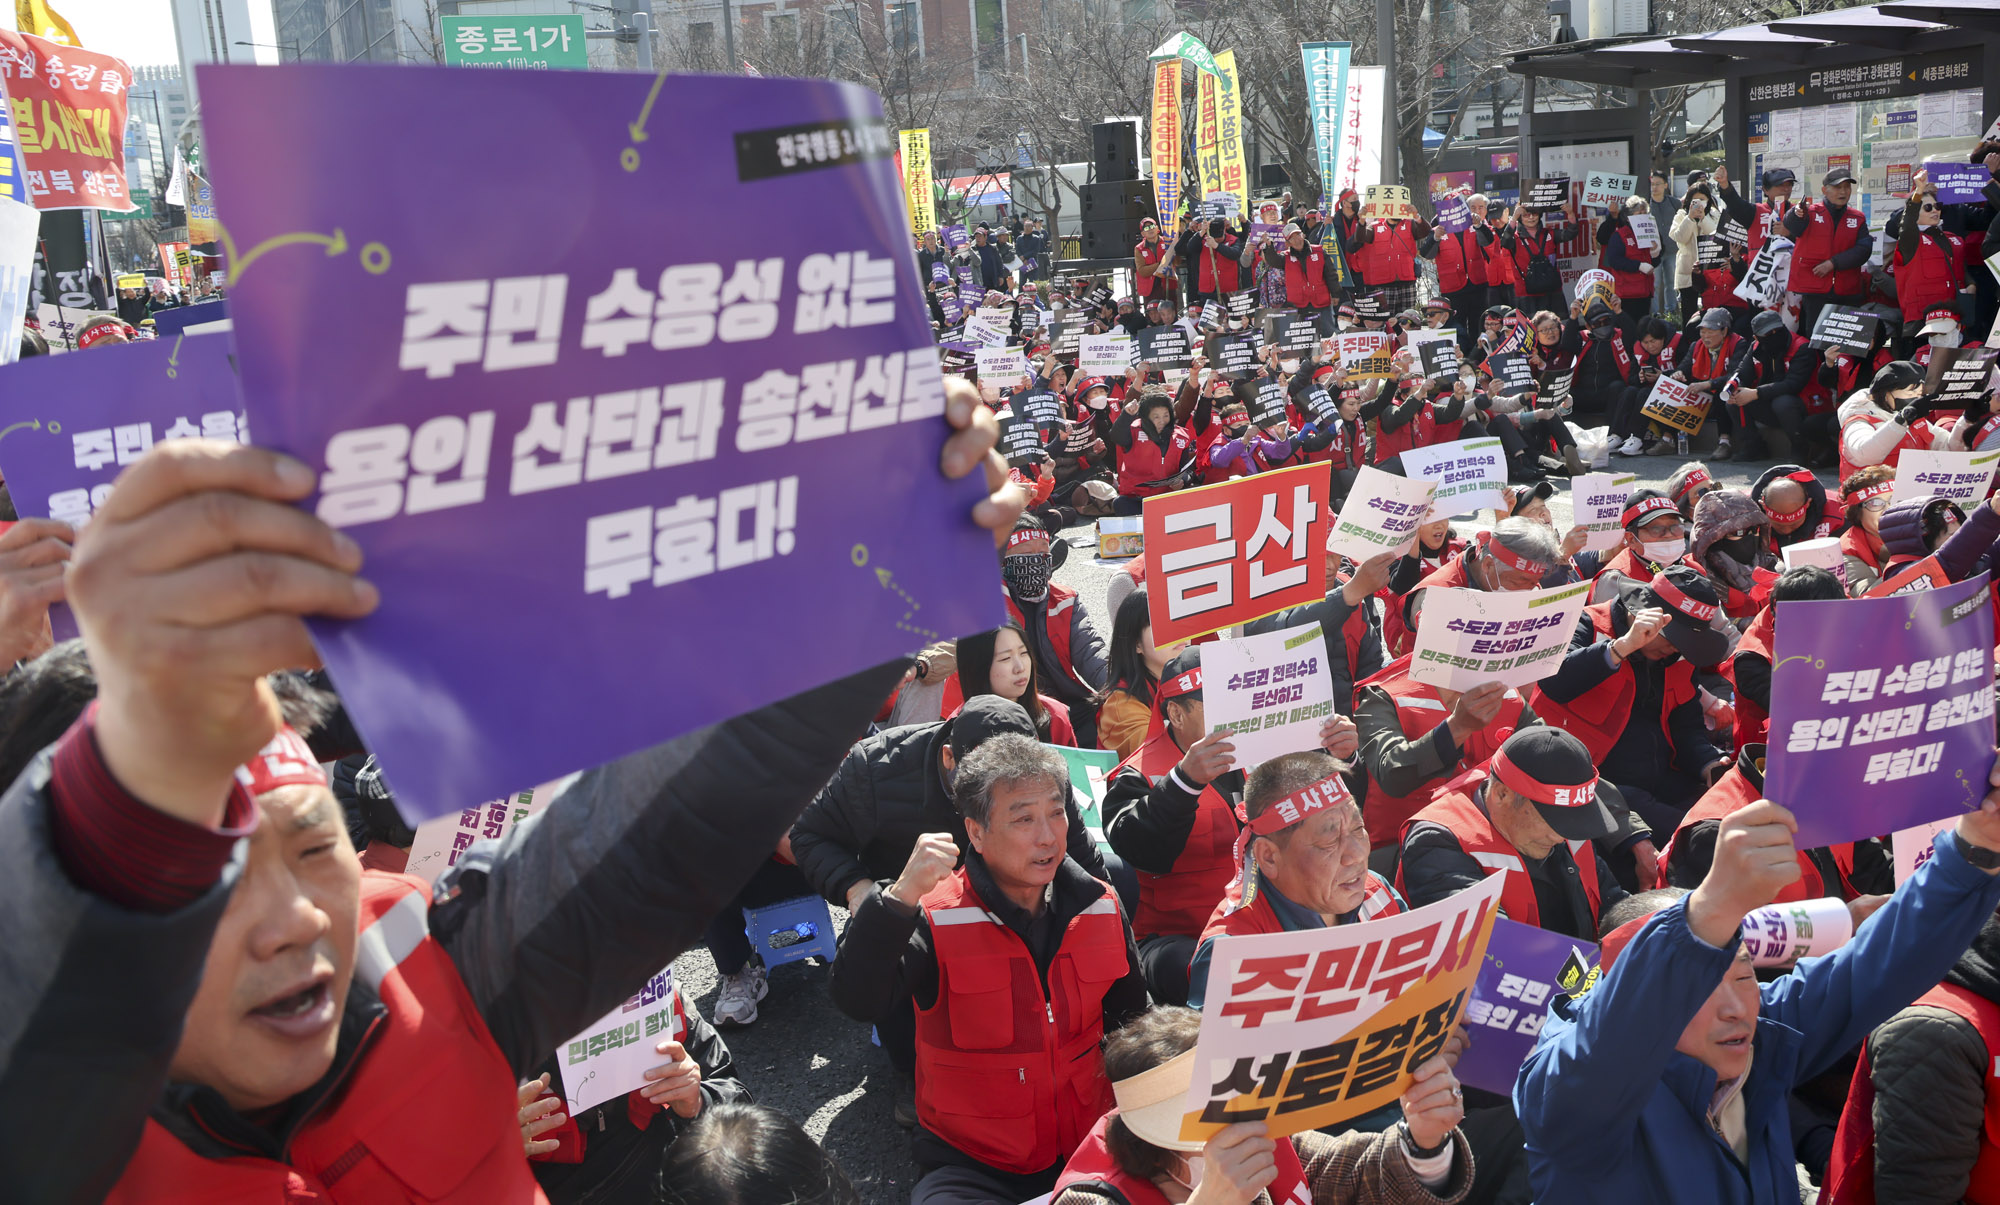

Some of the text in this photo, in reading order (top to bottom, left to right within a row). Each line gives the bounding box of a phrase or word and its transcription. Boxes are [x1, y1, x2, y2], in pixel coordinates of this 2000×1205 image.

[455, 24, 572, 54] 종로1가
[1749, 82, 1796, 101] 신한은행본점
[1922, 62, 1969, 81] 세종문화회관
[1755, 123, 1768, 134] 149
[1367, 187, 1410, 201] 무조건
[1590, 176, 1632, 190] 송전탑
[400, 251, 896, 379] 주민 수용성 없는
[1343, 337, 1388, 354] 주민무시
[1345, 357, 1392, 374] 선로결정
[1646, 399, 1702, 429] 선로결정
[72, 422, 153, 471] 주민
[315, 346, 947, 528] 용인 산단과 송전선로
[1423, 455, 1496, 476] 수도권 전력수요
[1444, 469, 1485, 484] 분산하고
[1914, 471, 1989, 485] 수도권 전력수요
[1367, 496, 1410, 516] 수도권
[584, 475, 799, 599] 무효다!
[1338, 521, 1389, 546] 민주적인
[1381, 517, 1420, 533] 분산하고
[1162, 484, 1317, 621] 금산
[1446, 611, 1565, 636] 수도권 전력수요
[1419, 642, 1568, 673] 민주적인 절차 마련하라!
[1470, 635, 1538, 655] 분산하고
[1227, 657, 1318, 691] 수도권 전력수요
[1821, 647, 1985, 704] 주민 수용성 없는
[1251, 683, 1303, 710] 분산하고
[1263, 711, 1287, 730] 절차
[1289, 699, 1333, 724] 마련하라!
[1786, 683, 1995, 752] 용인 산단과 송전선로
[1863, 741, 1945, 785] 무효다!
[1220, 895, 1493, 1029] 주민무시
[1496, 973, 1552, 1006] 주민
[1466, 999, 1519, 1031] 용인
[568, 1009, 671, 1066] 민주적인 절차
[1199, 987, 1468, 1124] 선로결정
